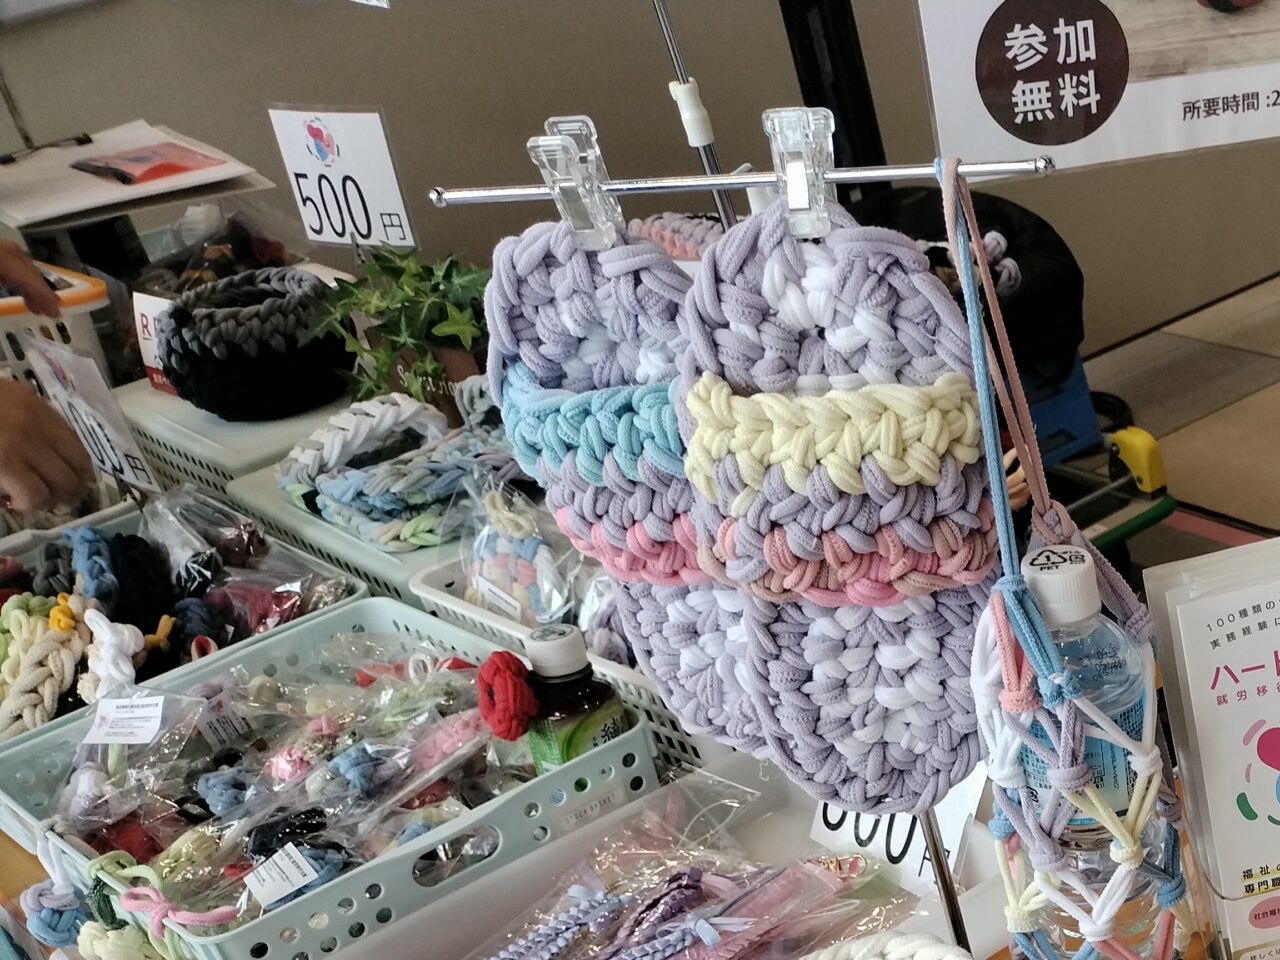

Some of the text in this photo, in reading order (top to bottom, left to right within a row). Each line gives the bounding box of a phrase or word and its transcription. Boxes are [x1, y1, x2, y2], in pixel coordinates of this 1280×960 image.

[1004, 19, 1097, 72] 参加
[1011, 69, 1101, 124] 無料
[1181, 91, 1261, 122] 所要時間
[293, 172, 408, 241] 500 円
